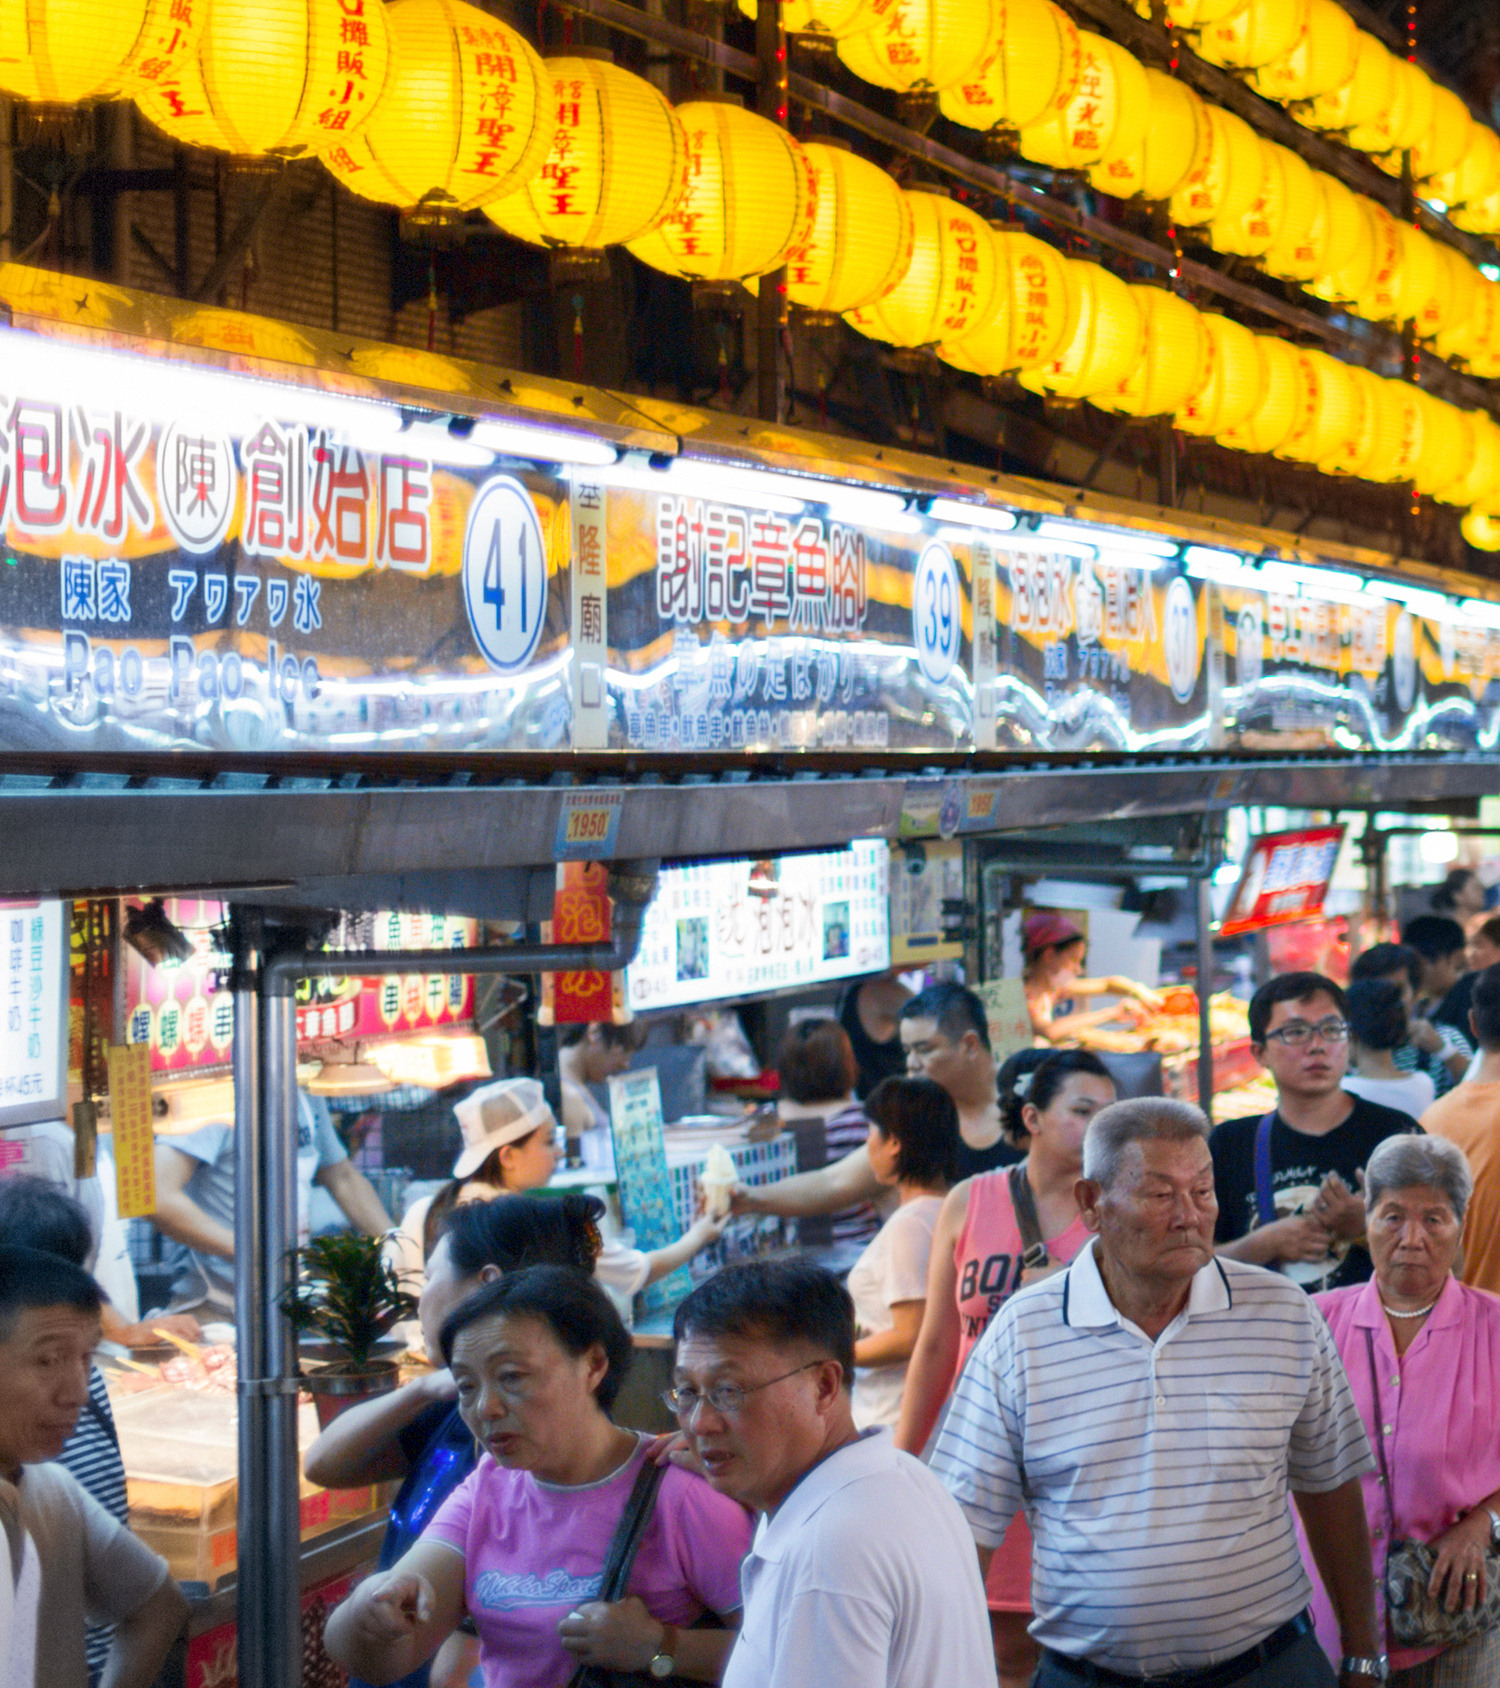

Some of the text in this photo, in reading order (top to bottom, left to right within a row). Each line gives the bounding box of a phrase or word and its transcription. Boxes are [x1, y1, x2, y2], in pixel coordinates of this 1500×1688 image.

[462, 52, 518, 178] 開漳聖王
[61, 556, 131, 620] 陳家
[480, 517, 529, 634] 41
[657, 497, 866, 632] 謝記章魚腳
[922, 570, 952, 660] 39
[64, 631, 320, 700] Pao Pao Ice
[571, 812, 606, 839] 1950
[960, 1252, 1026, 1303] BO
